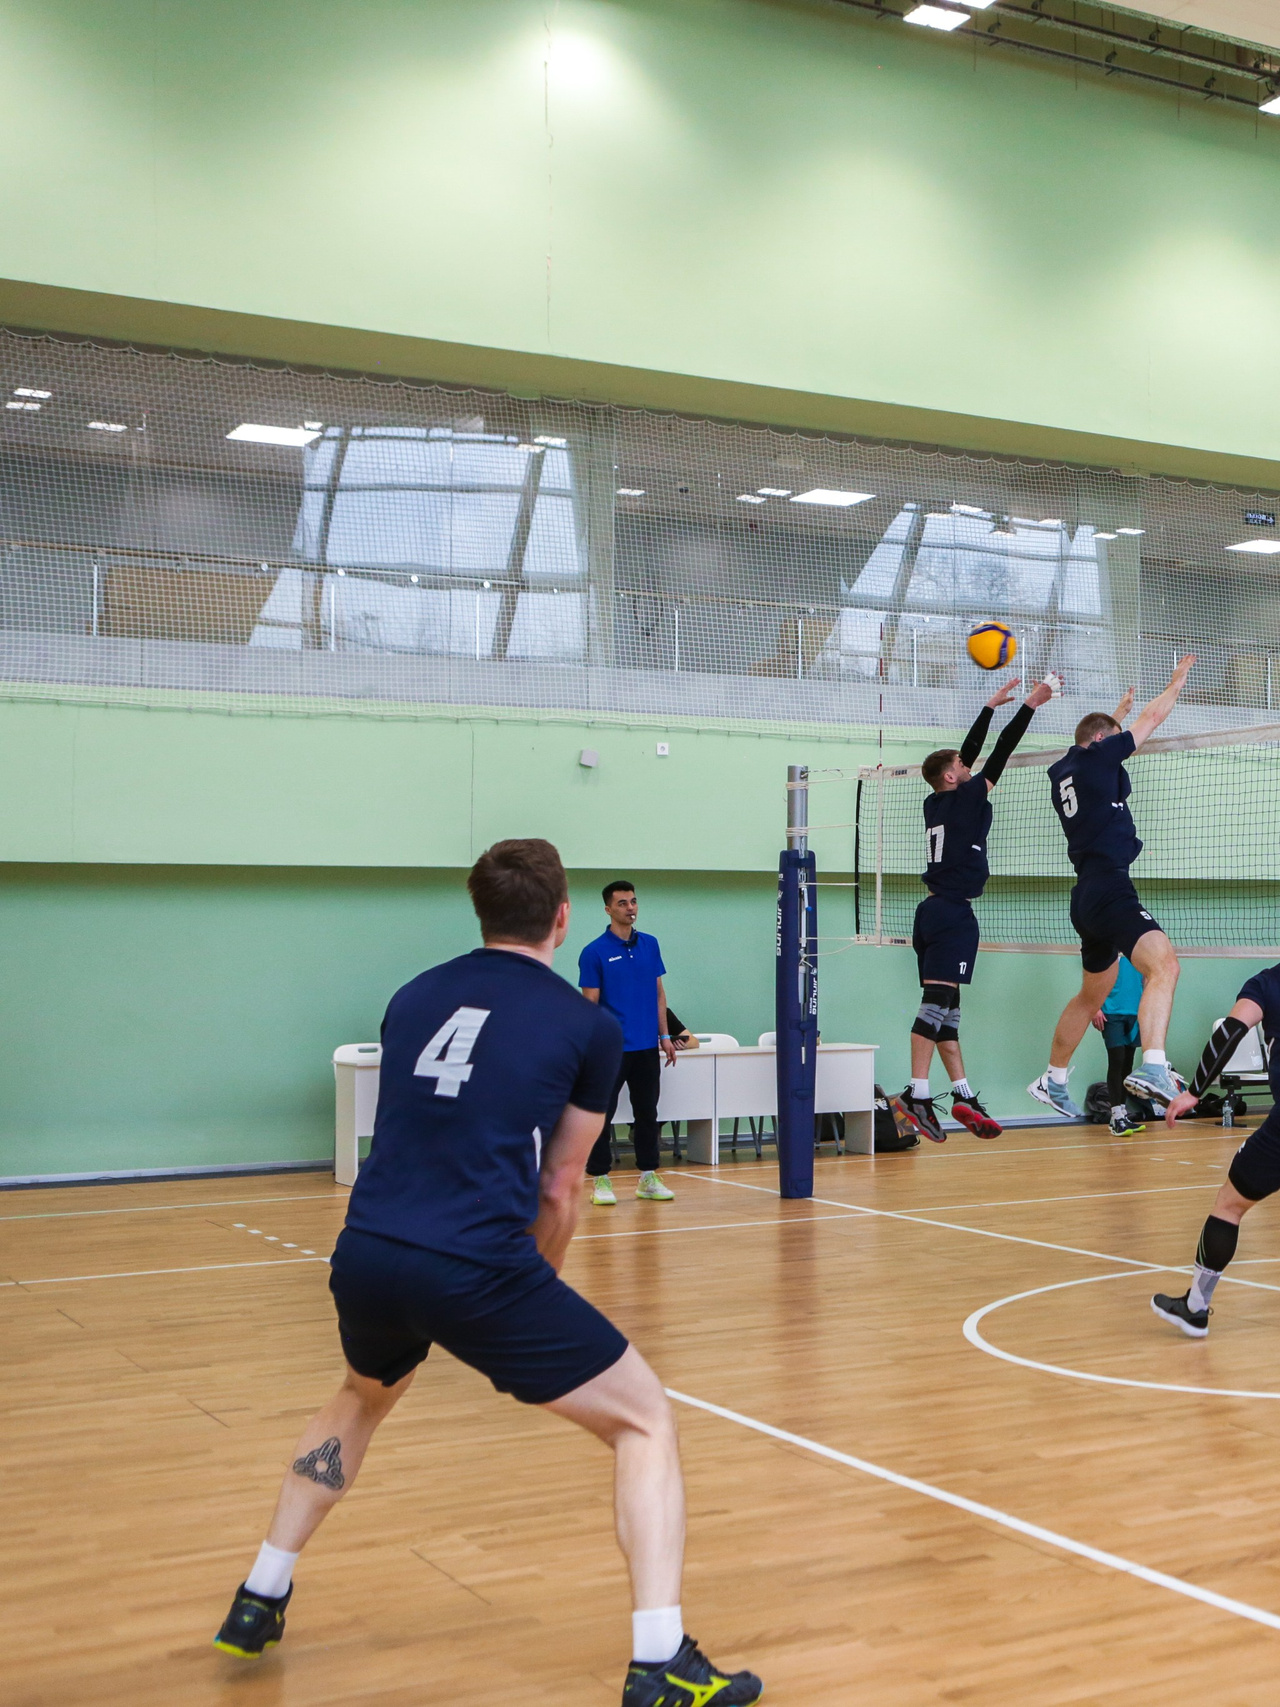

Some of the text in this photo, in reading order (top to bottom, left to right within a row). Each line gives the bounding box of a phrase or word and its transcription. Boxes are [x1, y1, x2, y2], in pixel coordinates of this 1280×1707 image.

[1059, 776, 1079, 818] 5
[926, 824, 945, 863] 17
[959, 961, 967, 975] 17
[413, 1006, 491, 1098] 4
